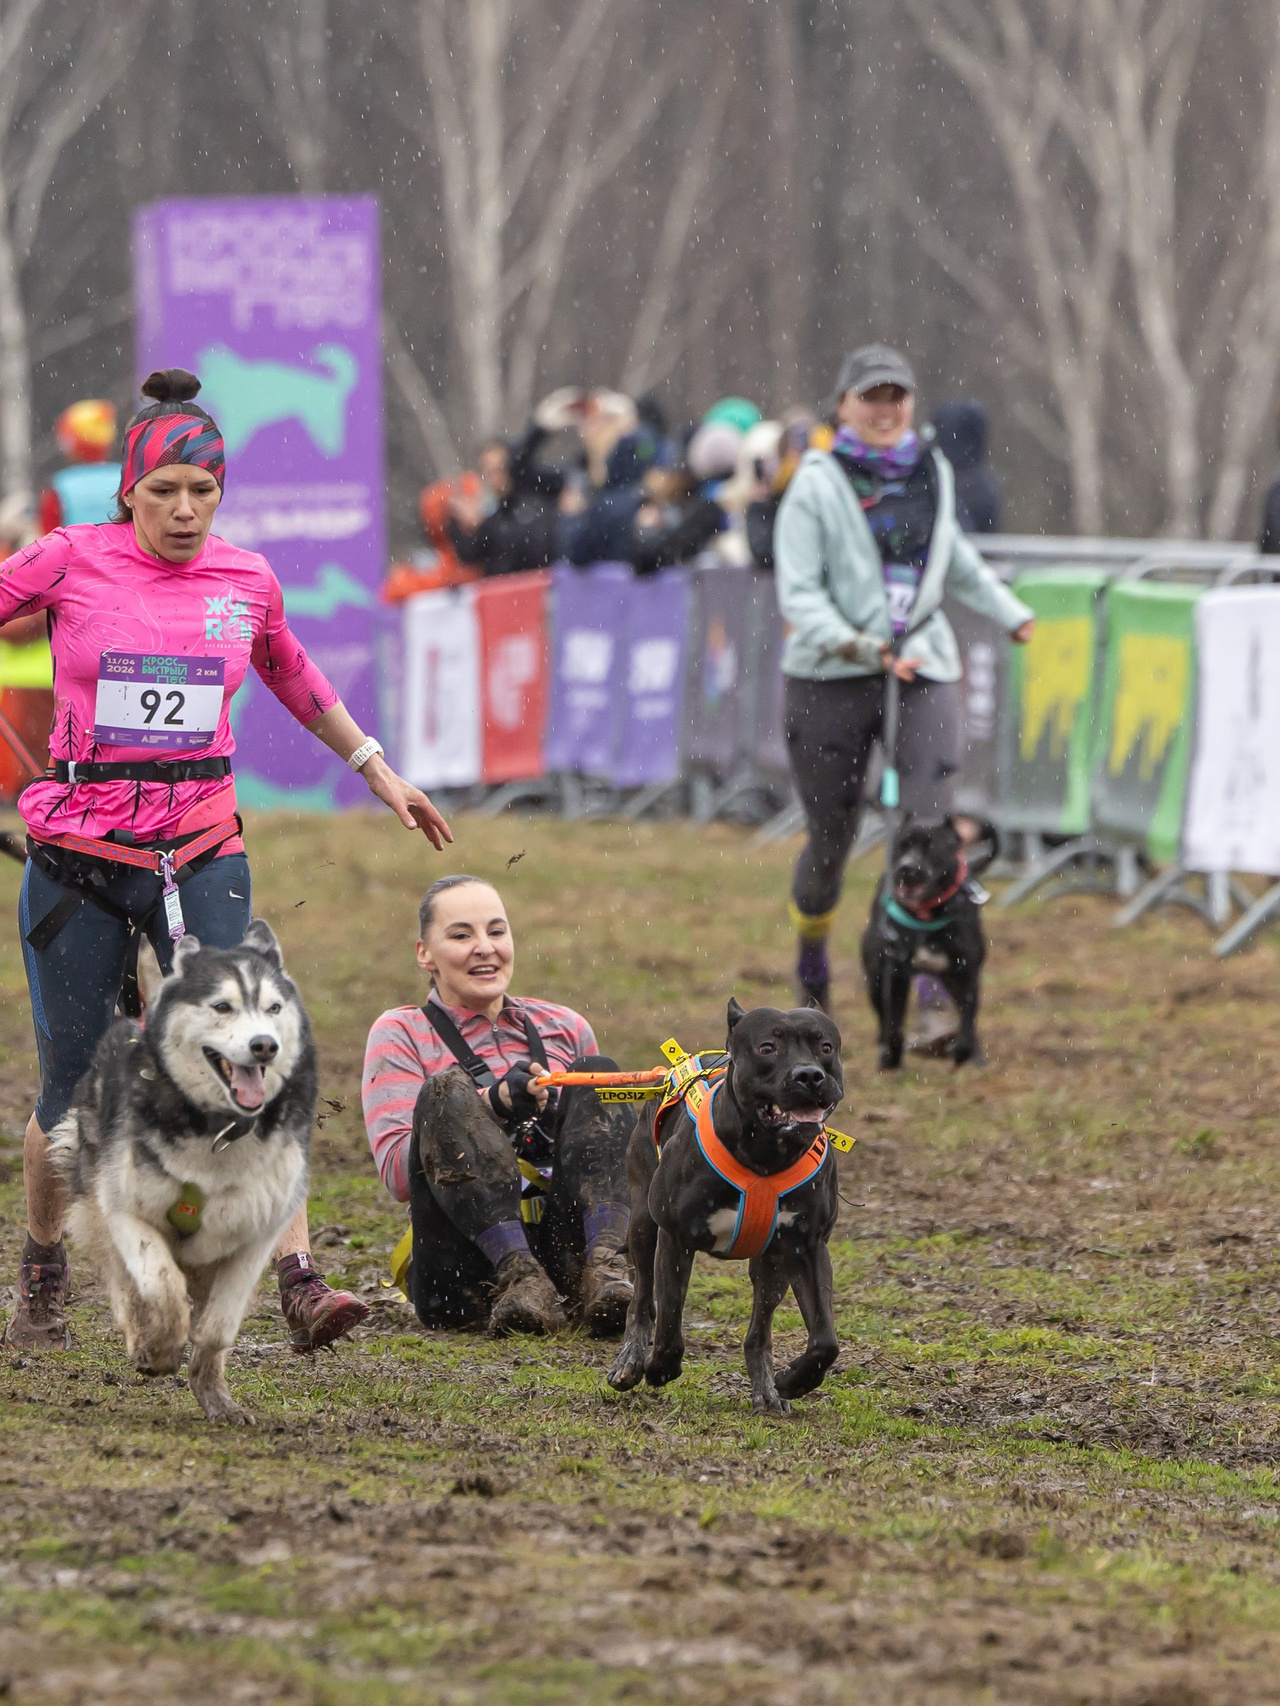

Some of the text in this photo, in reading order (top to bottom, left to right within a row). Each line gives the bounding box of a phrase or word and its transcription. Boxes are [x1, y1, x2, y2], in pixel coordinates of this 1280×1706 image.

[106, 665, 135, 674] 2026
[141, 665, 187, 676] БЫСТРЫЙ
[196, 668, 202, 676] 2
[140, 689, 185, 726] 92
